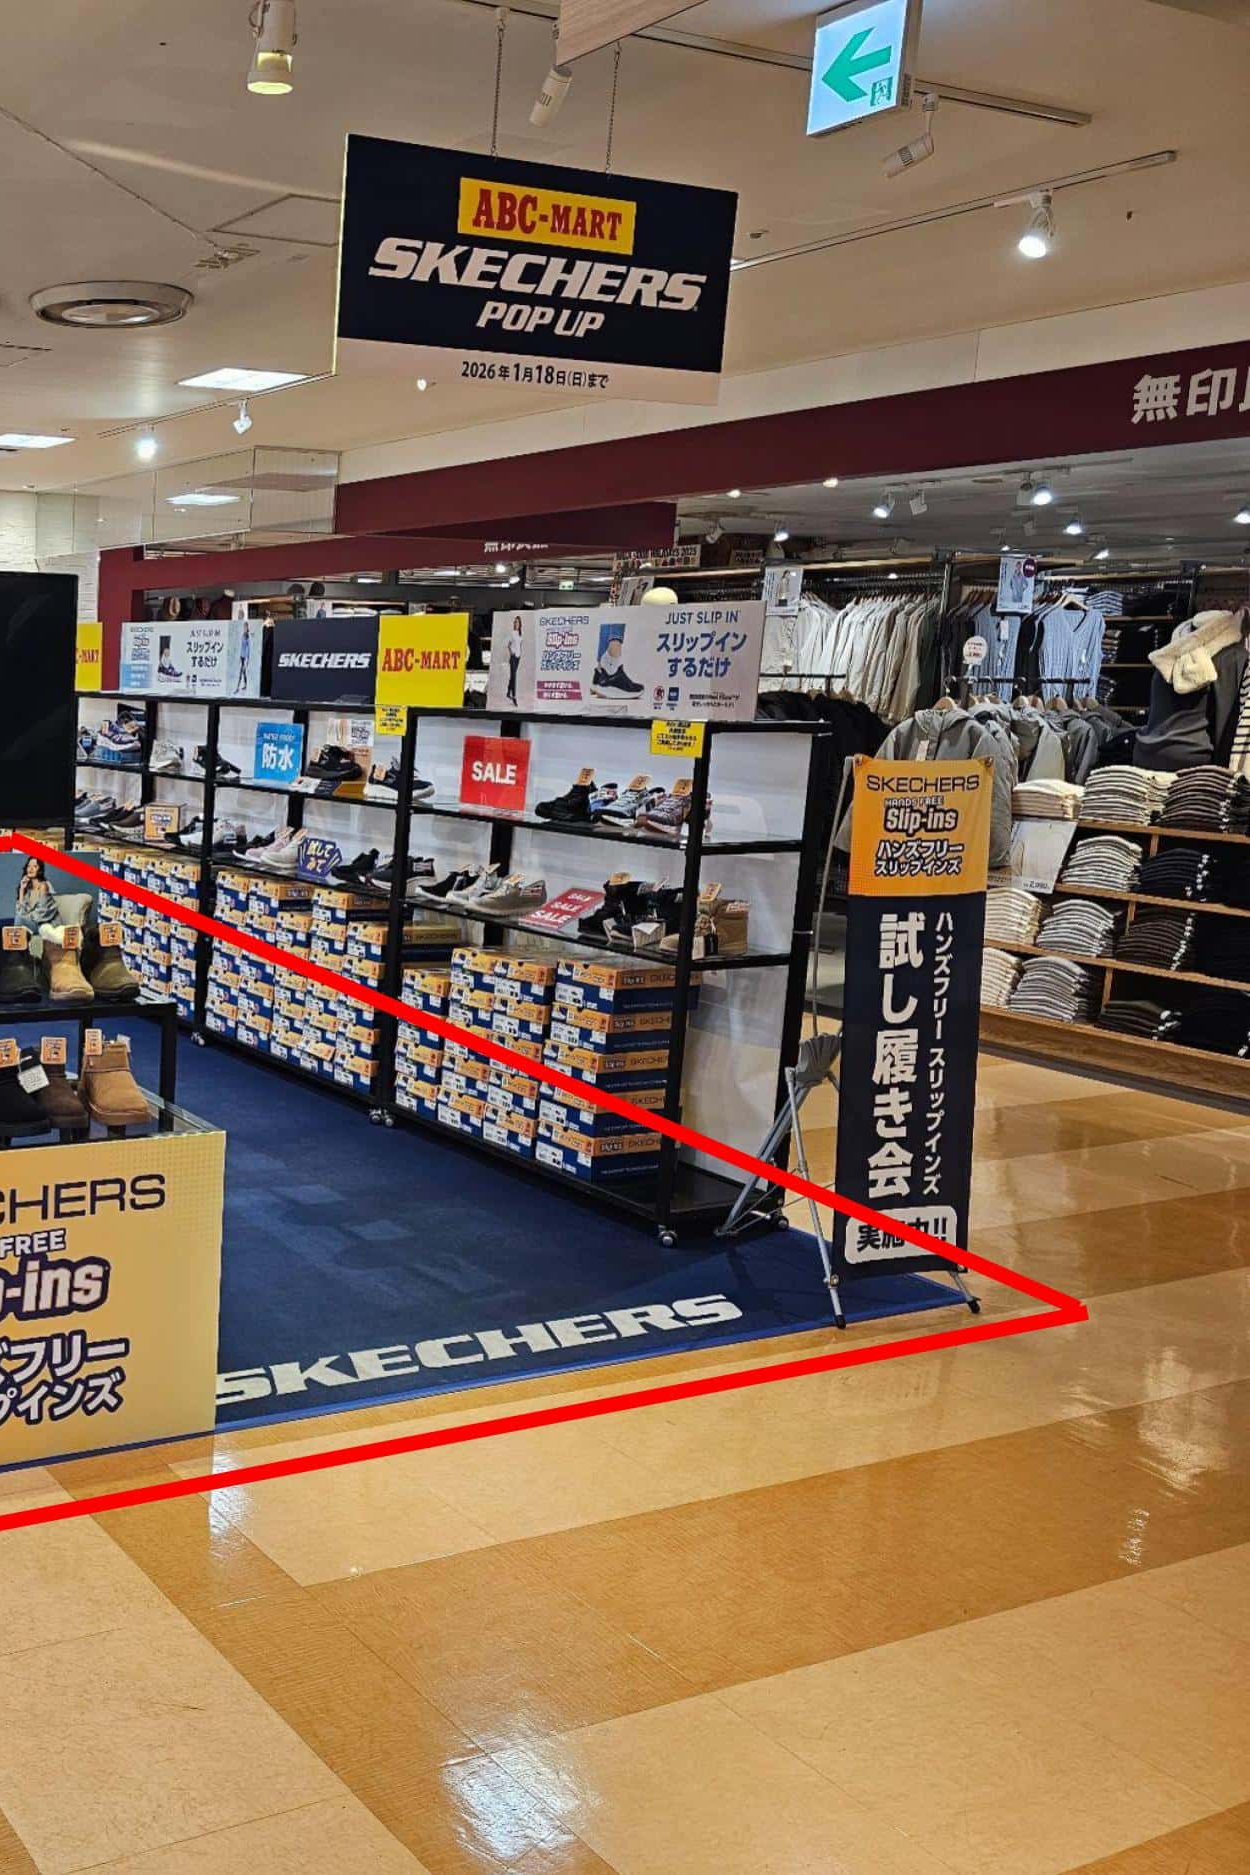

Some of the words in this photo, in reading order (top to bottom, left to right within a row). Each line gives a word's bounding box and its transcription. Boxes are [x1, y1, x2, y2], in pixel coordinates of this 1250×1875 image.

[472, 188, 622, 241] ABC-MART
[368, 236, 707, 311] SKECHERS
[476, 301, 551, 332] POP
[554, 309, 605, 338] UP
[1131, 366, 1250, 424] 無印
[665, 612, 694, 625] JUST
[696, 611, 723, 624] SLIP
[725, 610, 739, 623] IN
[656, 630, 747, 652] スリップイン
[76, 649, 99, 664] -MART
[277, 652, 372, 669] SKECHERS
[381, 648, 461, 672] ABC-MART
[667, 656, 732, 678] するだけ
[261, 743, 294, 771] 防水
[471, 761, 517, 785] SALE
[866, 775, 980, 793] SKECHERS
[885, 808, 958, 836] Slip-ins
[877, 840, 964, 859] ハンズフリー
[875, 859, 961, 876] スリップインズ
[530, 909, 572, 924] SALE
[930, 912, 955, 1041] ハンズフリー
[867, 911, 926, 1200] 試し履き会
[922, 1047, 947, 1196] スリップインズ
[215, 1294, 743, 1406] SKECHERS
